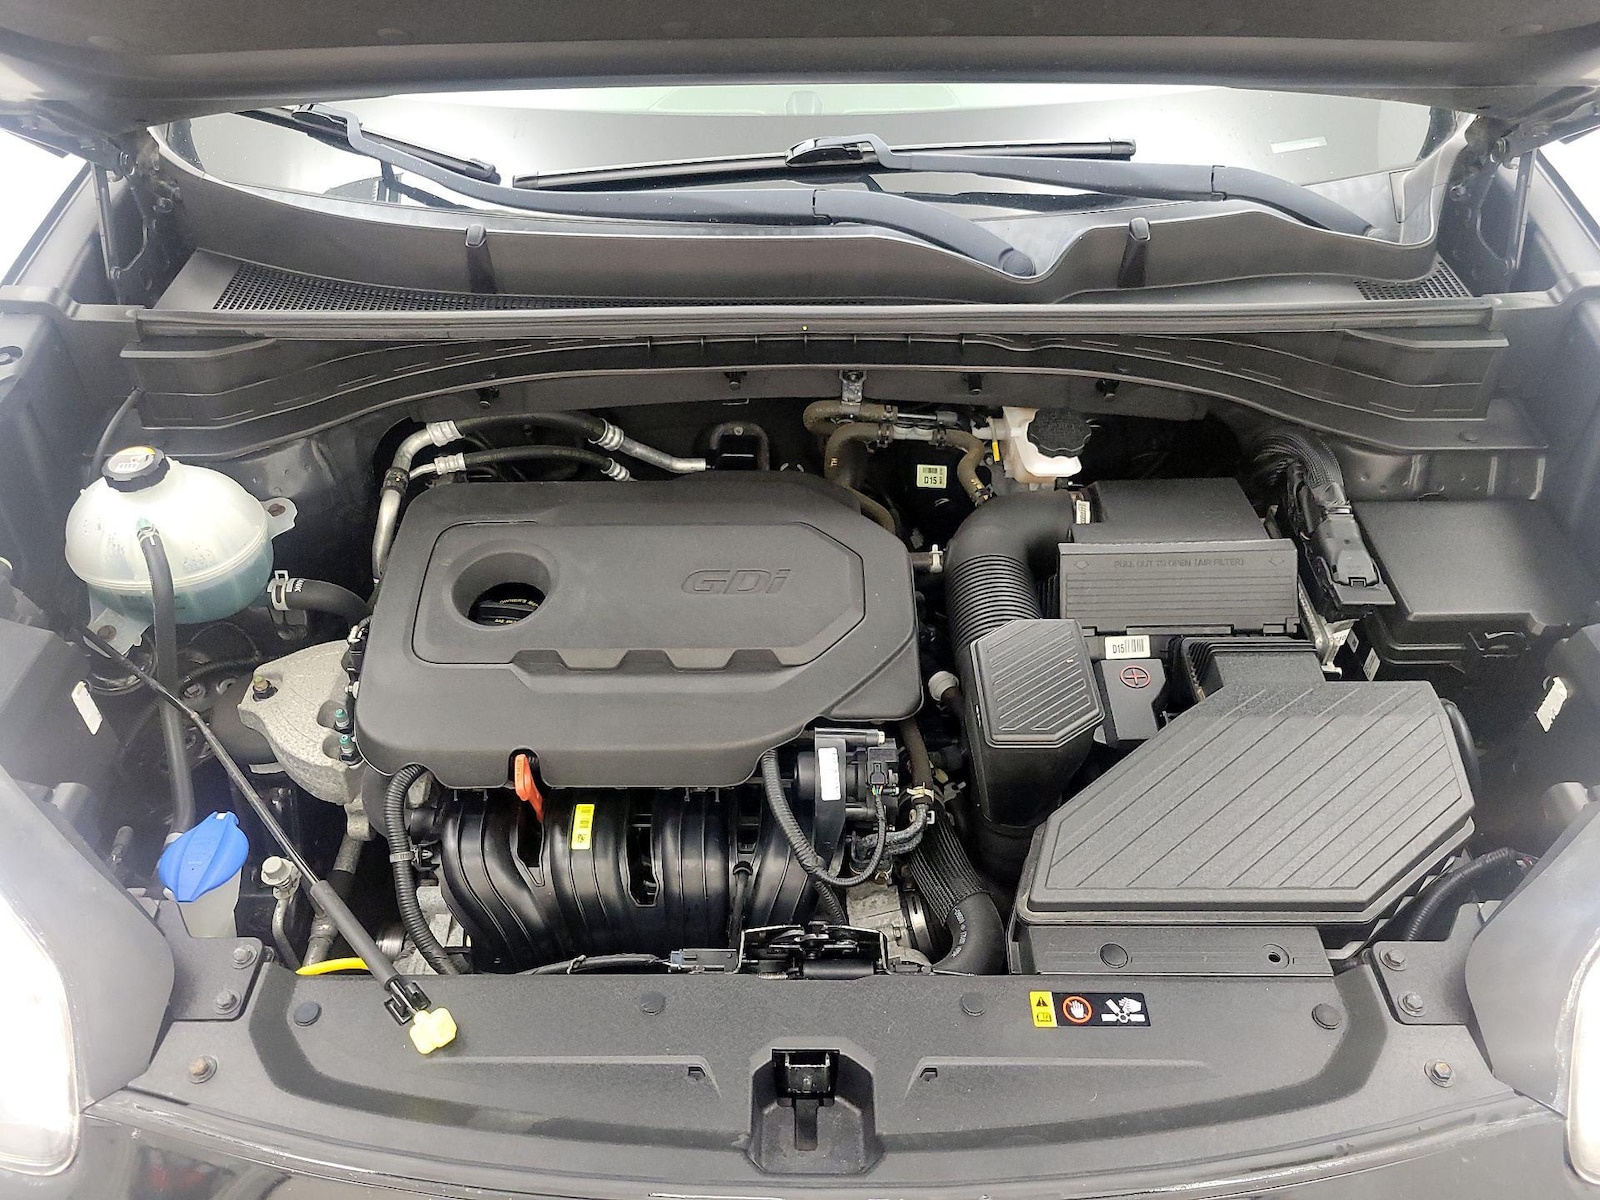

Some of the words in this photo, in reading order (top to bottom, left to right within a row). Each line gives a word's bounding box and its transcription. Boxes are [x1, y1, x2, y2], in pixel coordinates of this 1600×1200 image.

[1113, 560, 1135, 569] PULL
[1136, 560, 1153, 569] OUT
[1112, 643, 1125, 654] D15
